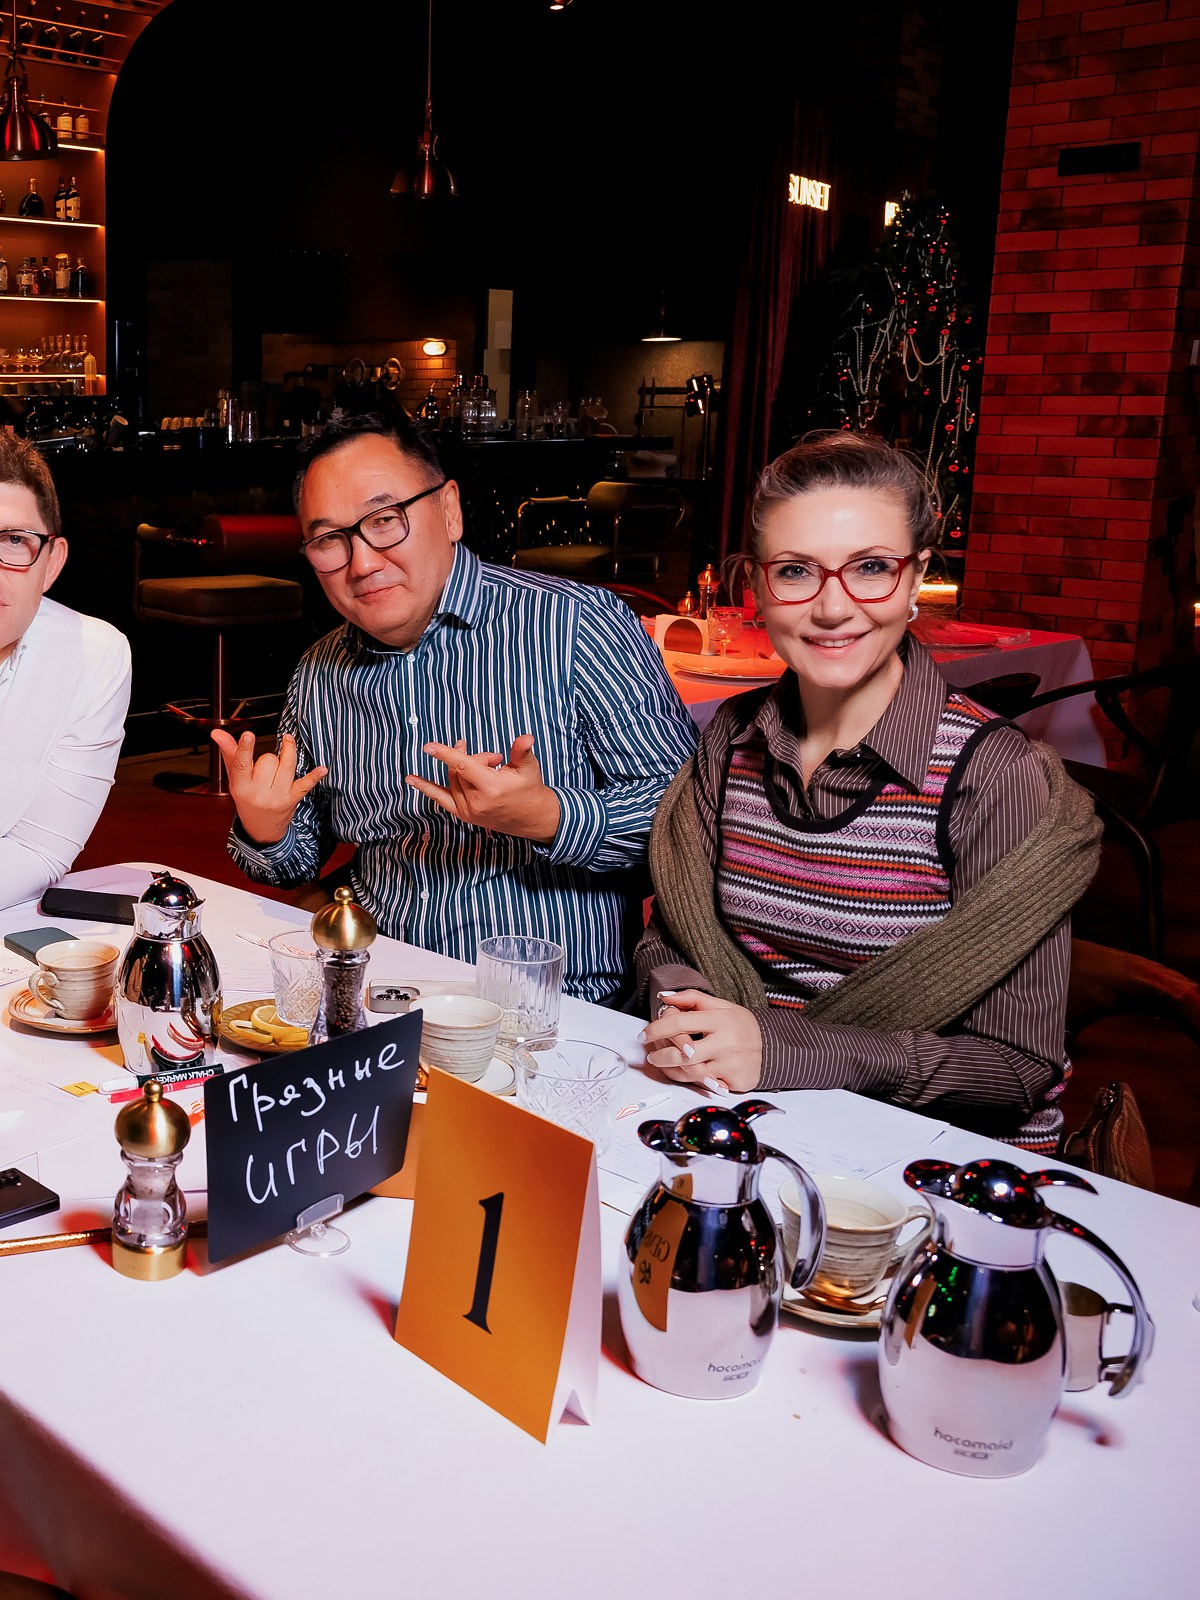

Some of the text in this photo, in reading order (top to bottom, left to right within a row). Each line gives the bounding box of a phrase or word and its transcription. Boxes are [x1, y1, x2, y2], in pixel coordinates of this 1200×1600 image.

[788, 173, 831, 211] SUNSET
[188, 1069, 215, 1080] CHALK
[228, 1043, 405, 1132] Грязные
[461, 1191, 505, 1335] 1
